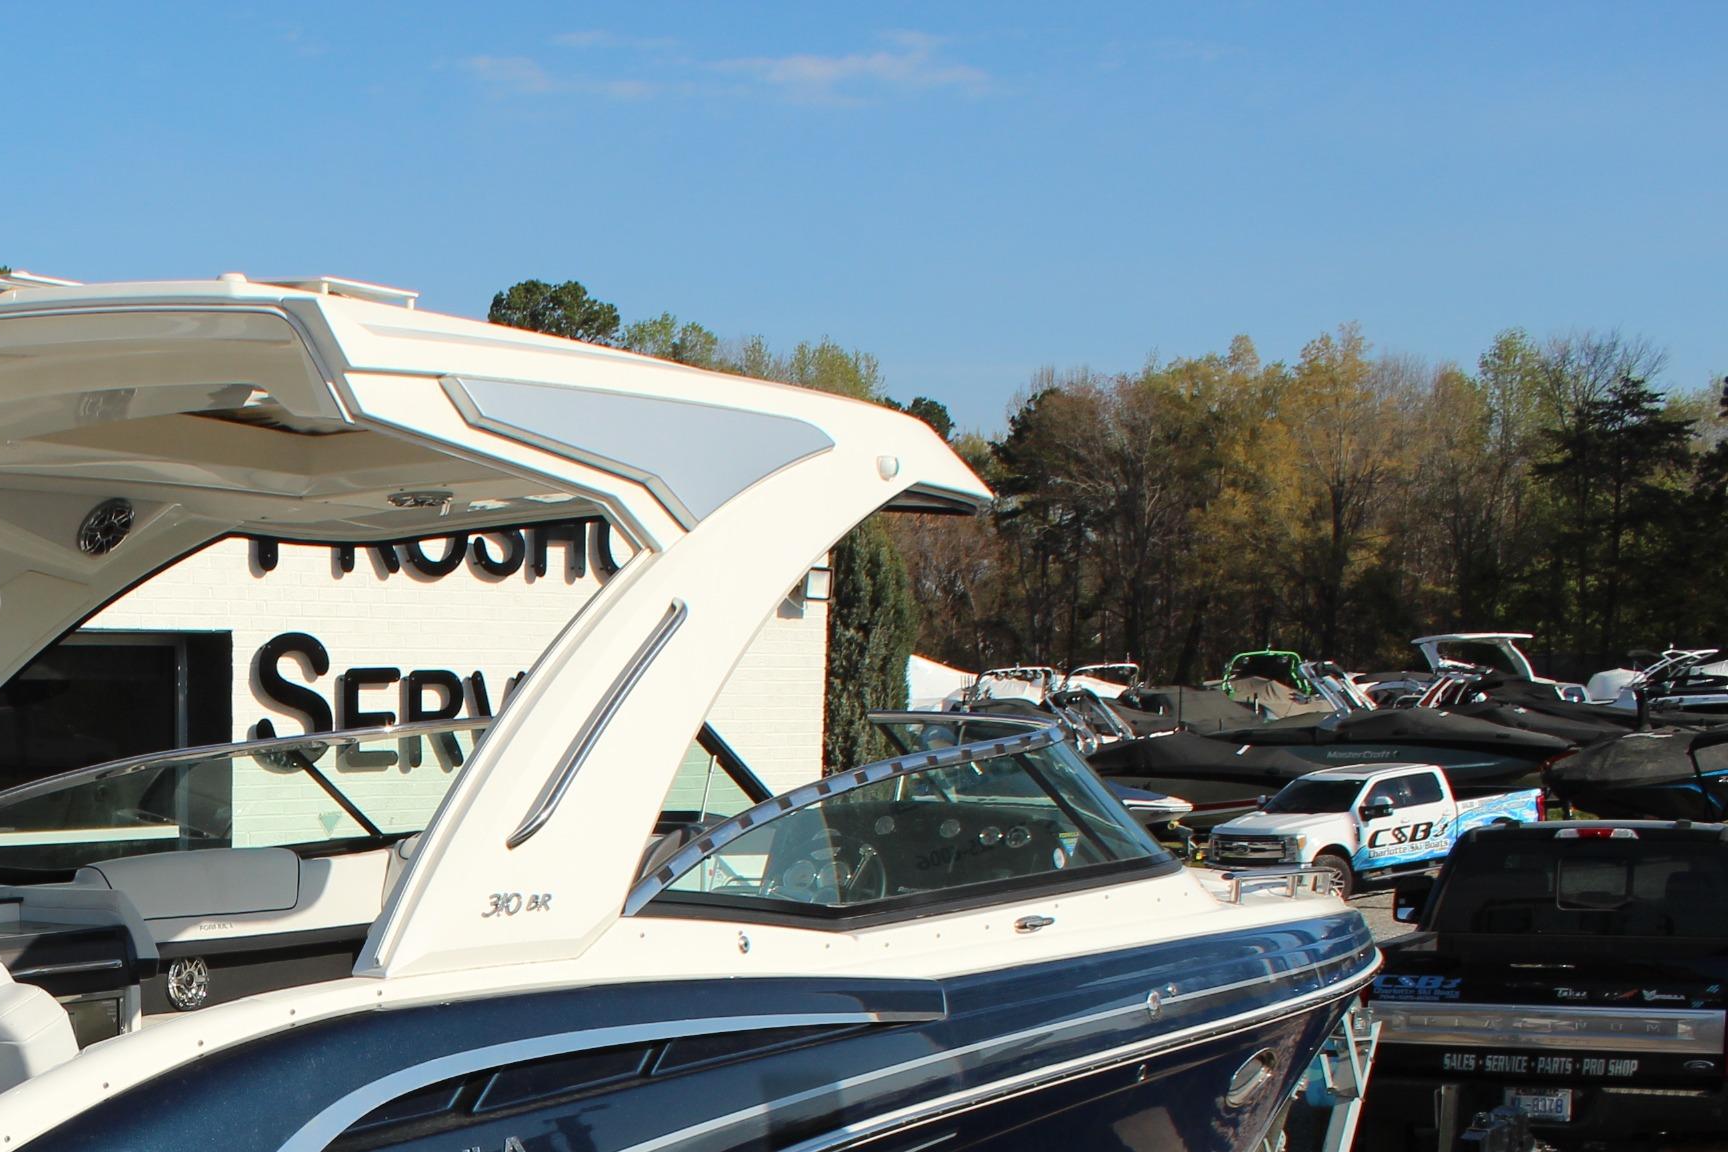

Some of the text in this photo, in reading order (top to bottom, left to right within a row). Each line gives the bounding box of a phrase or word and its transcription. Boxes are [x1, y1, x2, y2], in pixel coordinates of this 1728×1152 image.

[1368, 821, 1433, 848] CSB
[1368, 846, 1408, 859] Charlotte
[481, 892, 553, 919] 310 BR
[1374, 975, 1445, 988] CSB
[1443, 1053, 1639, 1077] SALES SERVICE PARTS PRO SHOP
